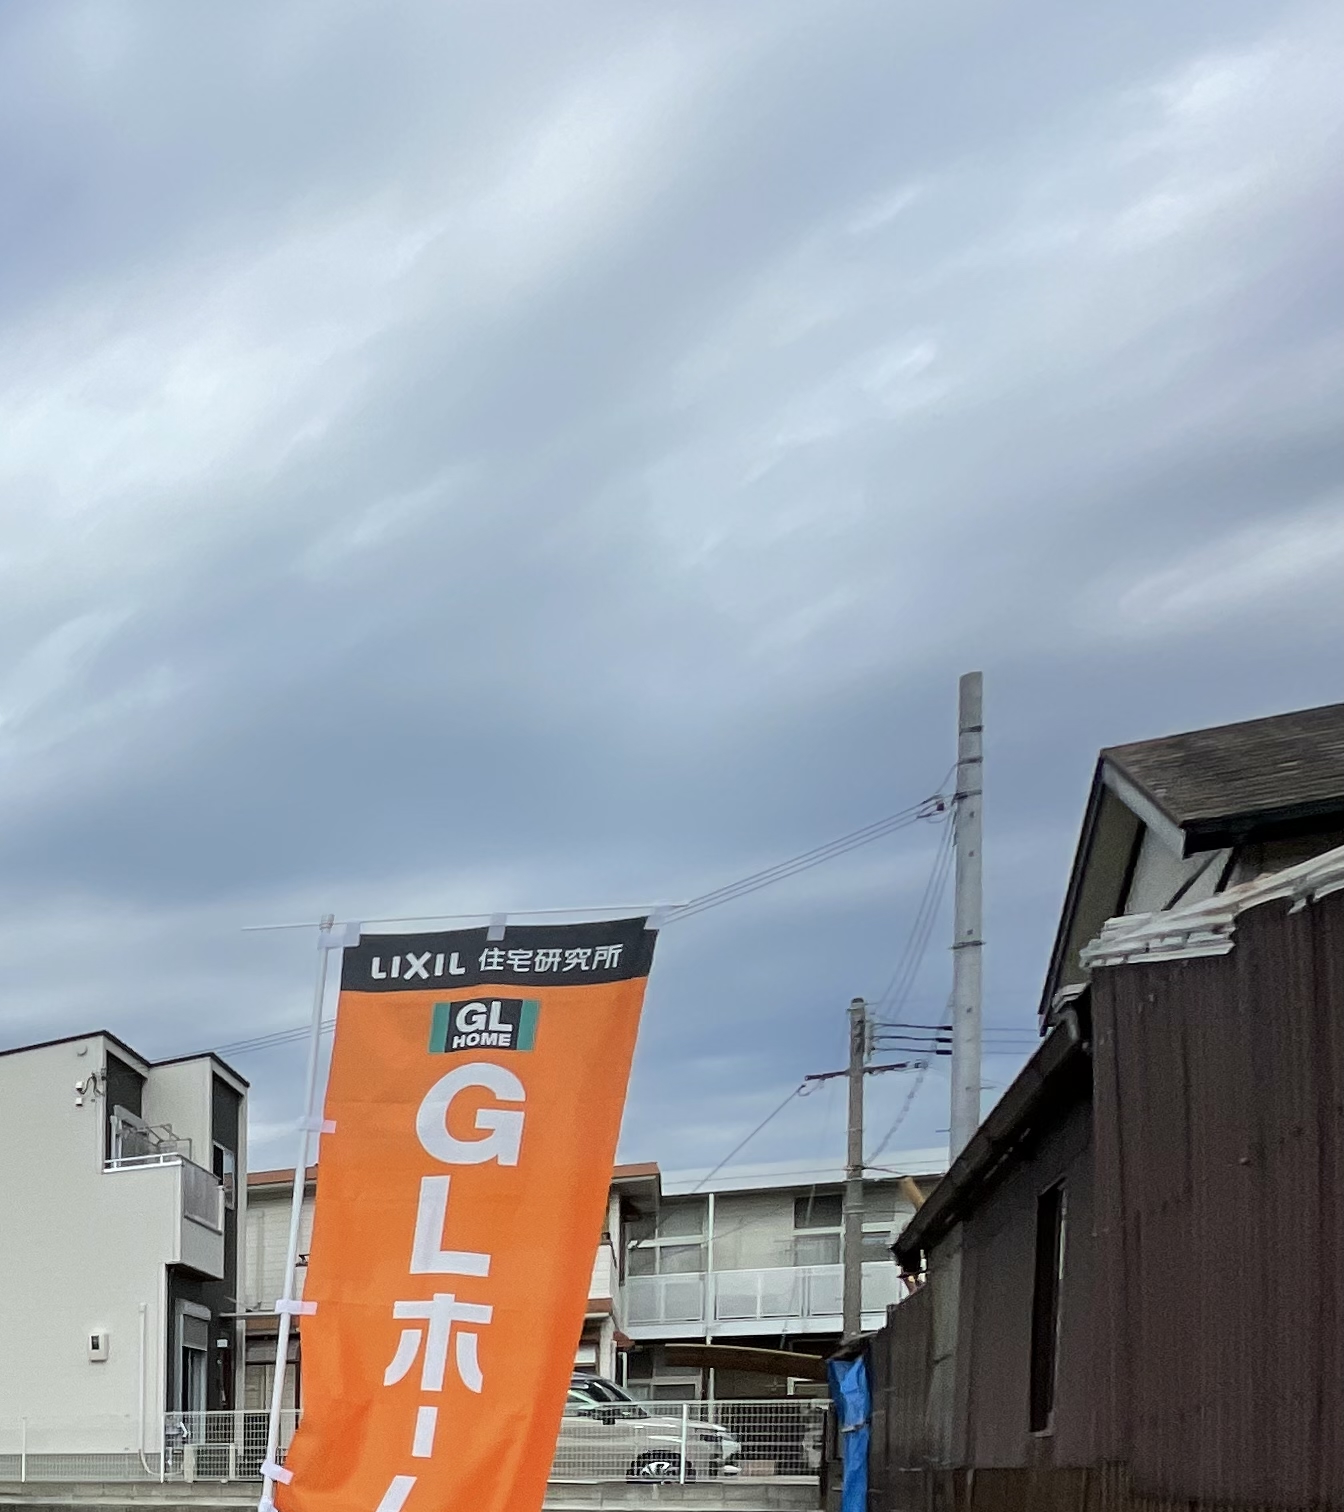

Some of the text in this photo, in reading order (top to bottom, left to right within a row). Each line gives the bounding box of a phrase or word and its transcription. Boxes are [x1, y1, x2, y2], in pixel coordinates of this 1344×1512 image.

[370, 943, 624, 980] LIXIL 住宅研究所
[454, 1001, 513, 1034] GL
[452, 1032, 511, 1049] HOME
